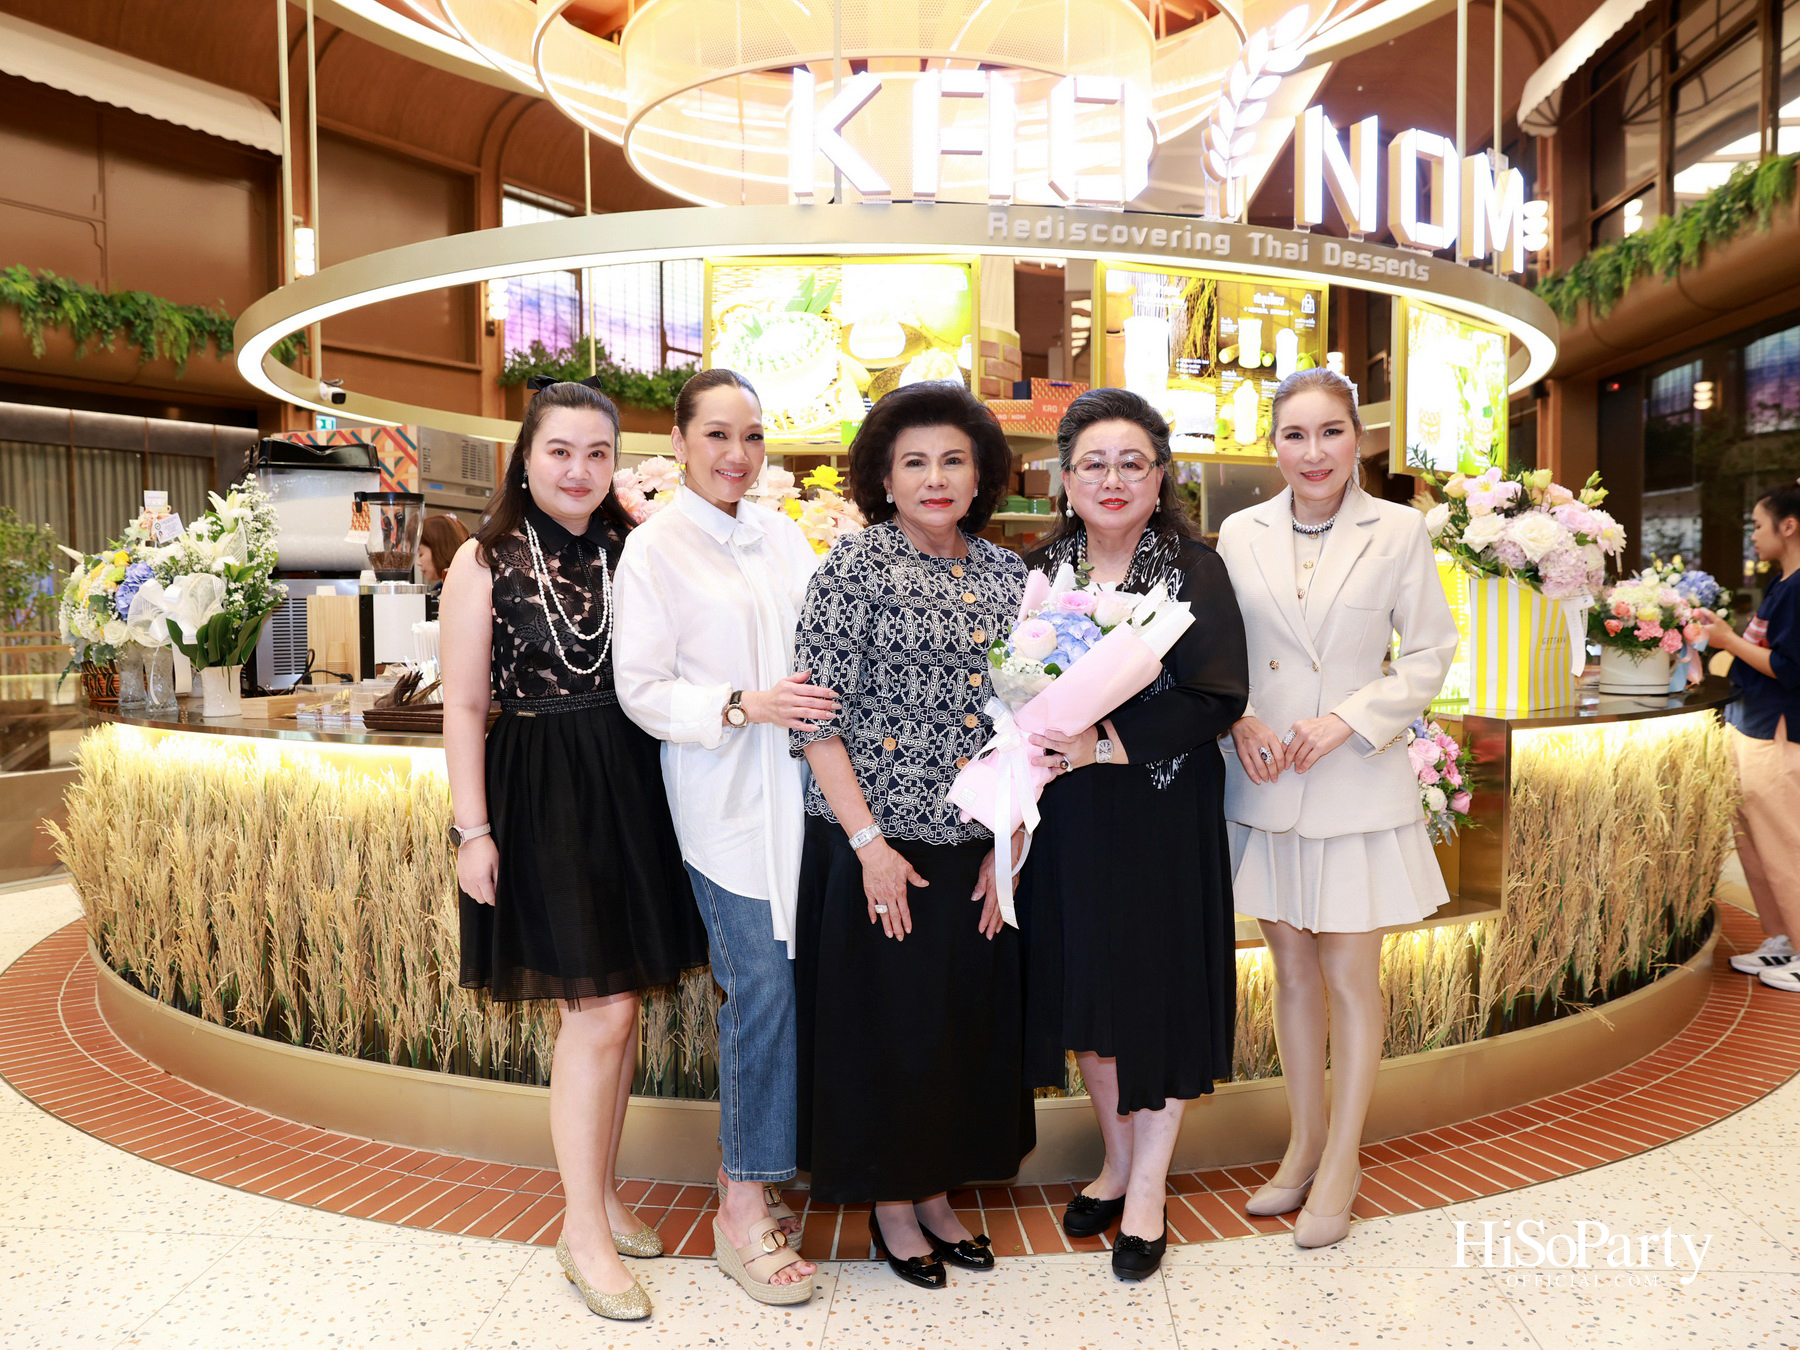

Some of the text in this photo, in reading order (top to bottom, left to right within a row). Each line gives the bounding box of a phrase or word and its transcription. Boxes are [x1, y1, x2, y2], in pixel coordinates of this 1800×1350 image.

[987, 211, 1430, 282] Rediscovering Thai Desserts
[1294, 104, 1525, 274] NOM
